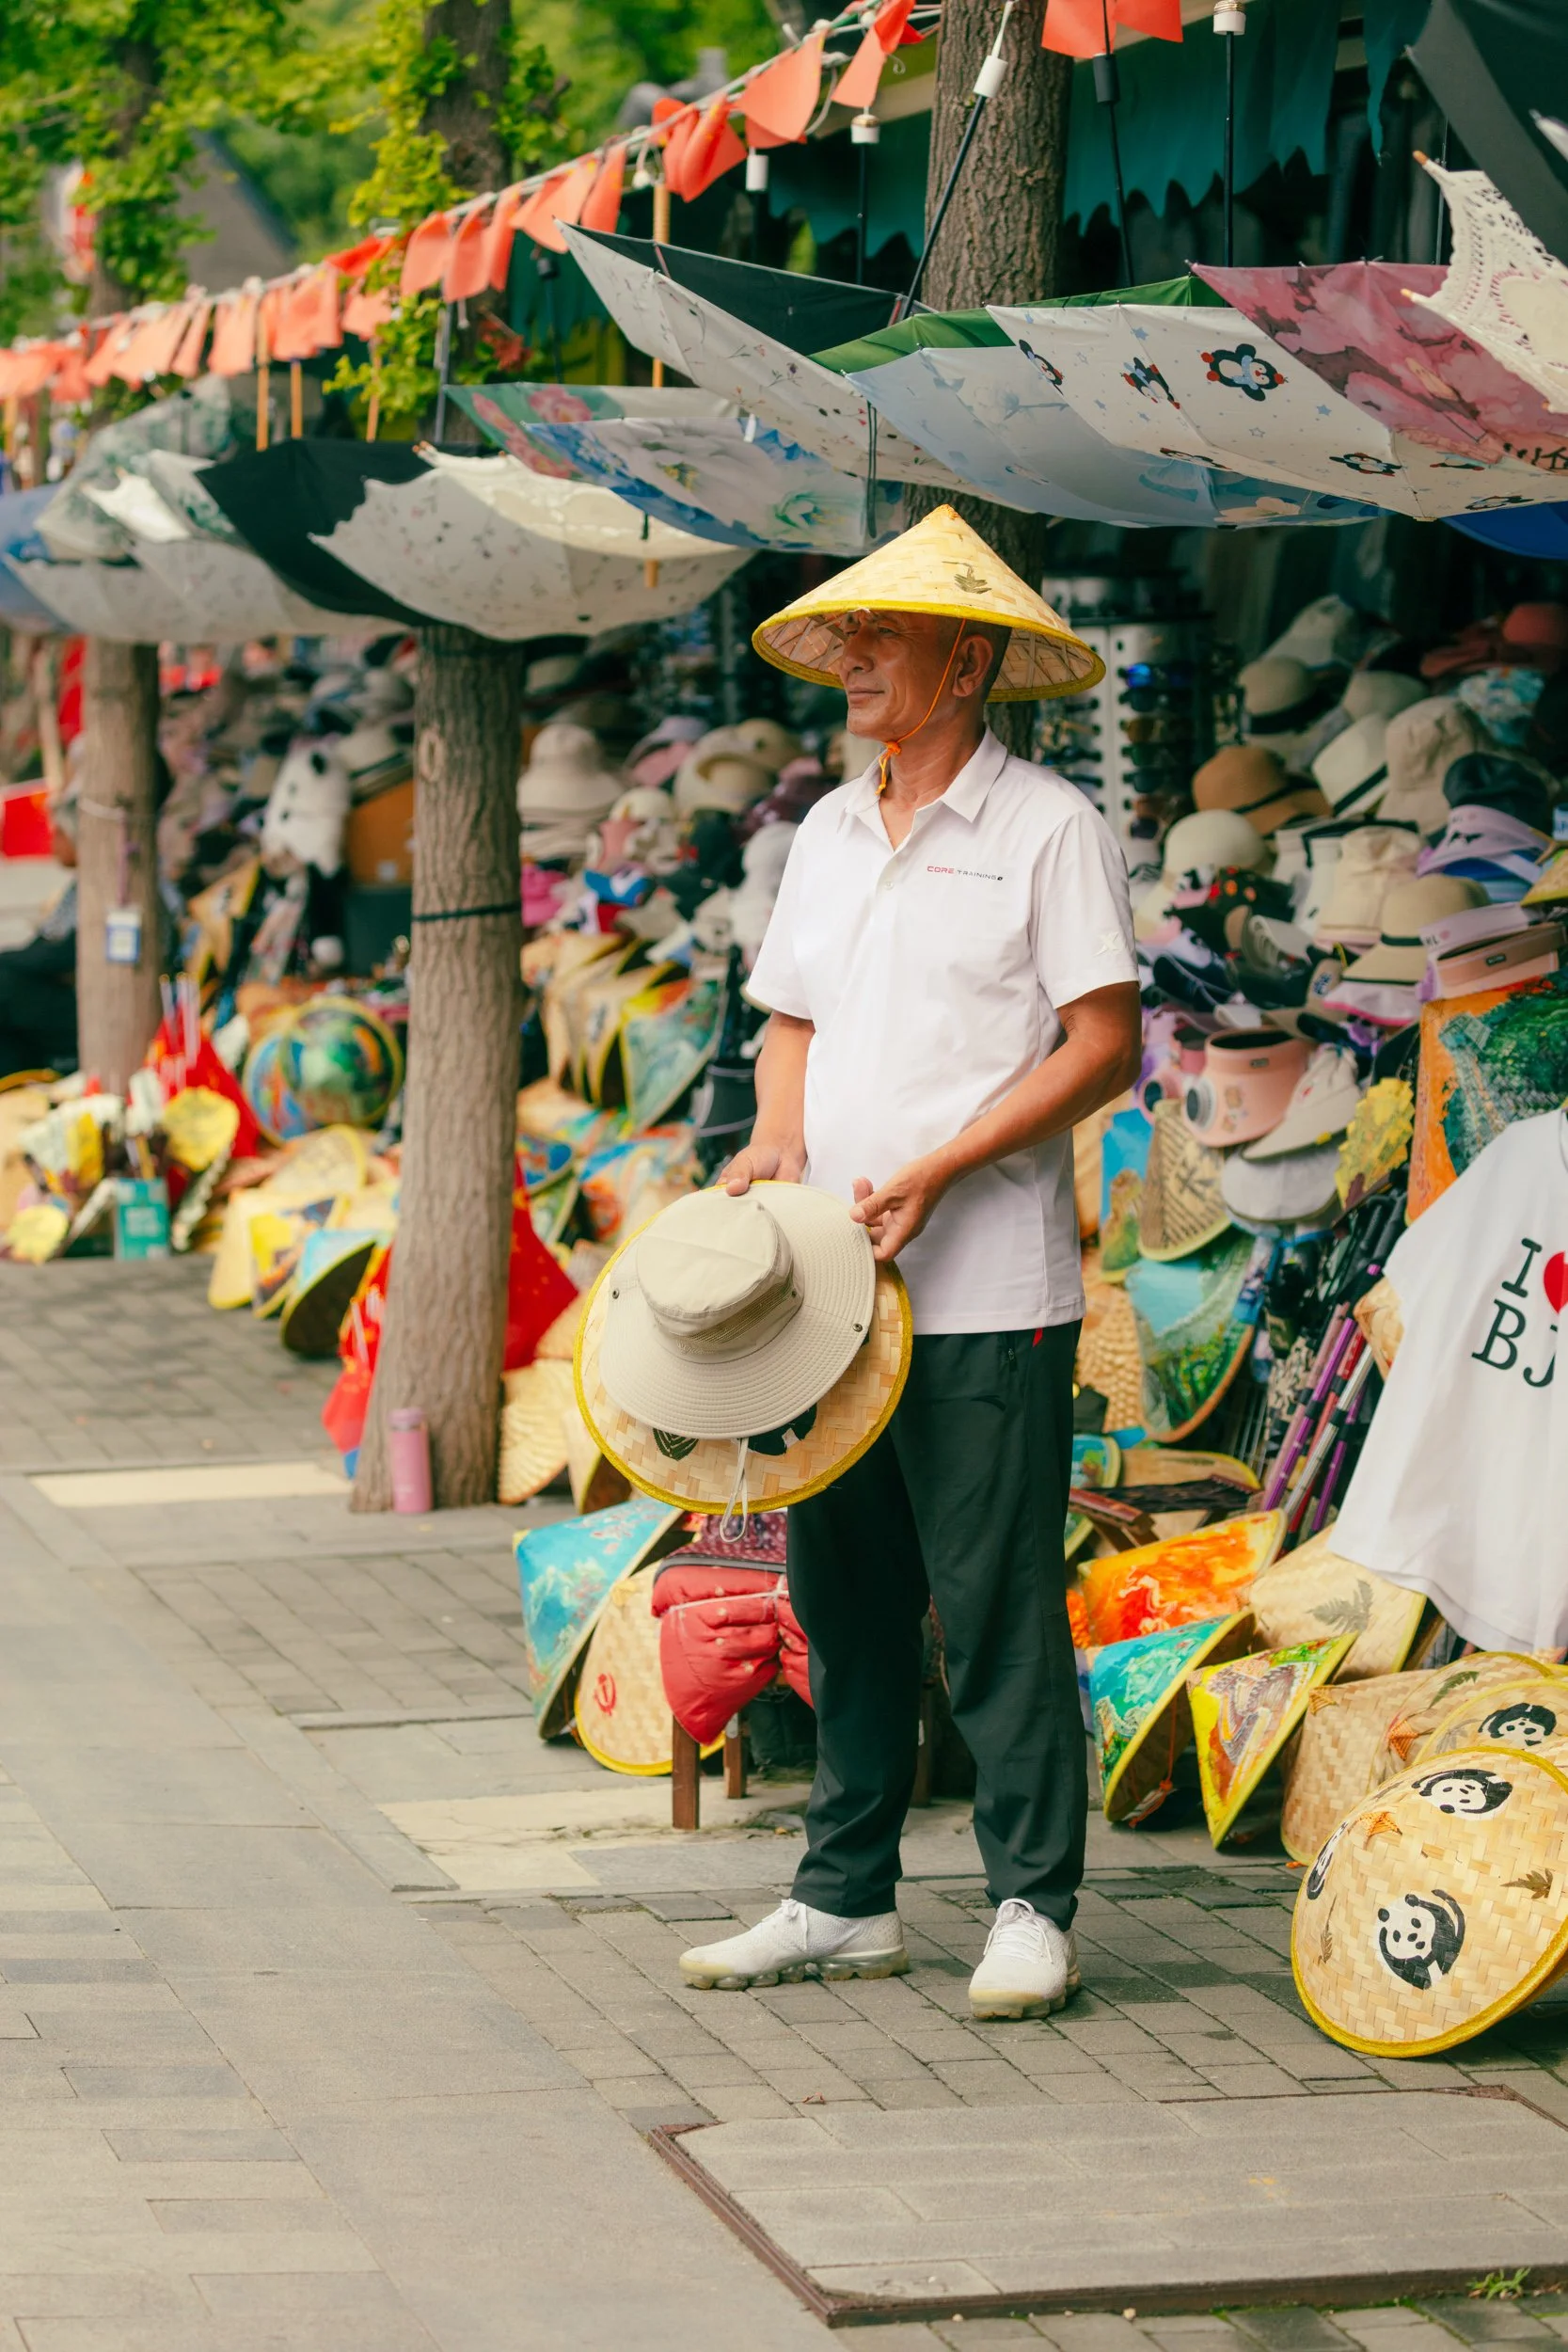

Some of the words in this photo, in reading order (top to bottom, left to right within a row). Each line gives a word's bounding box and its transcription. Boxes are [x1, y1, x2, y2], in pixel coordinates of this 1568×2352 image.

[927, 866, 955, 875] CORE
[957, 869, 998, 881] TRAINING
[1501, 1237, 1543, 1298] I
